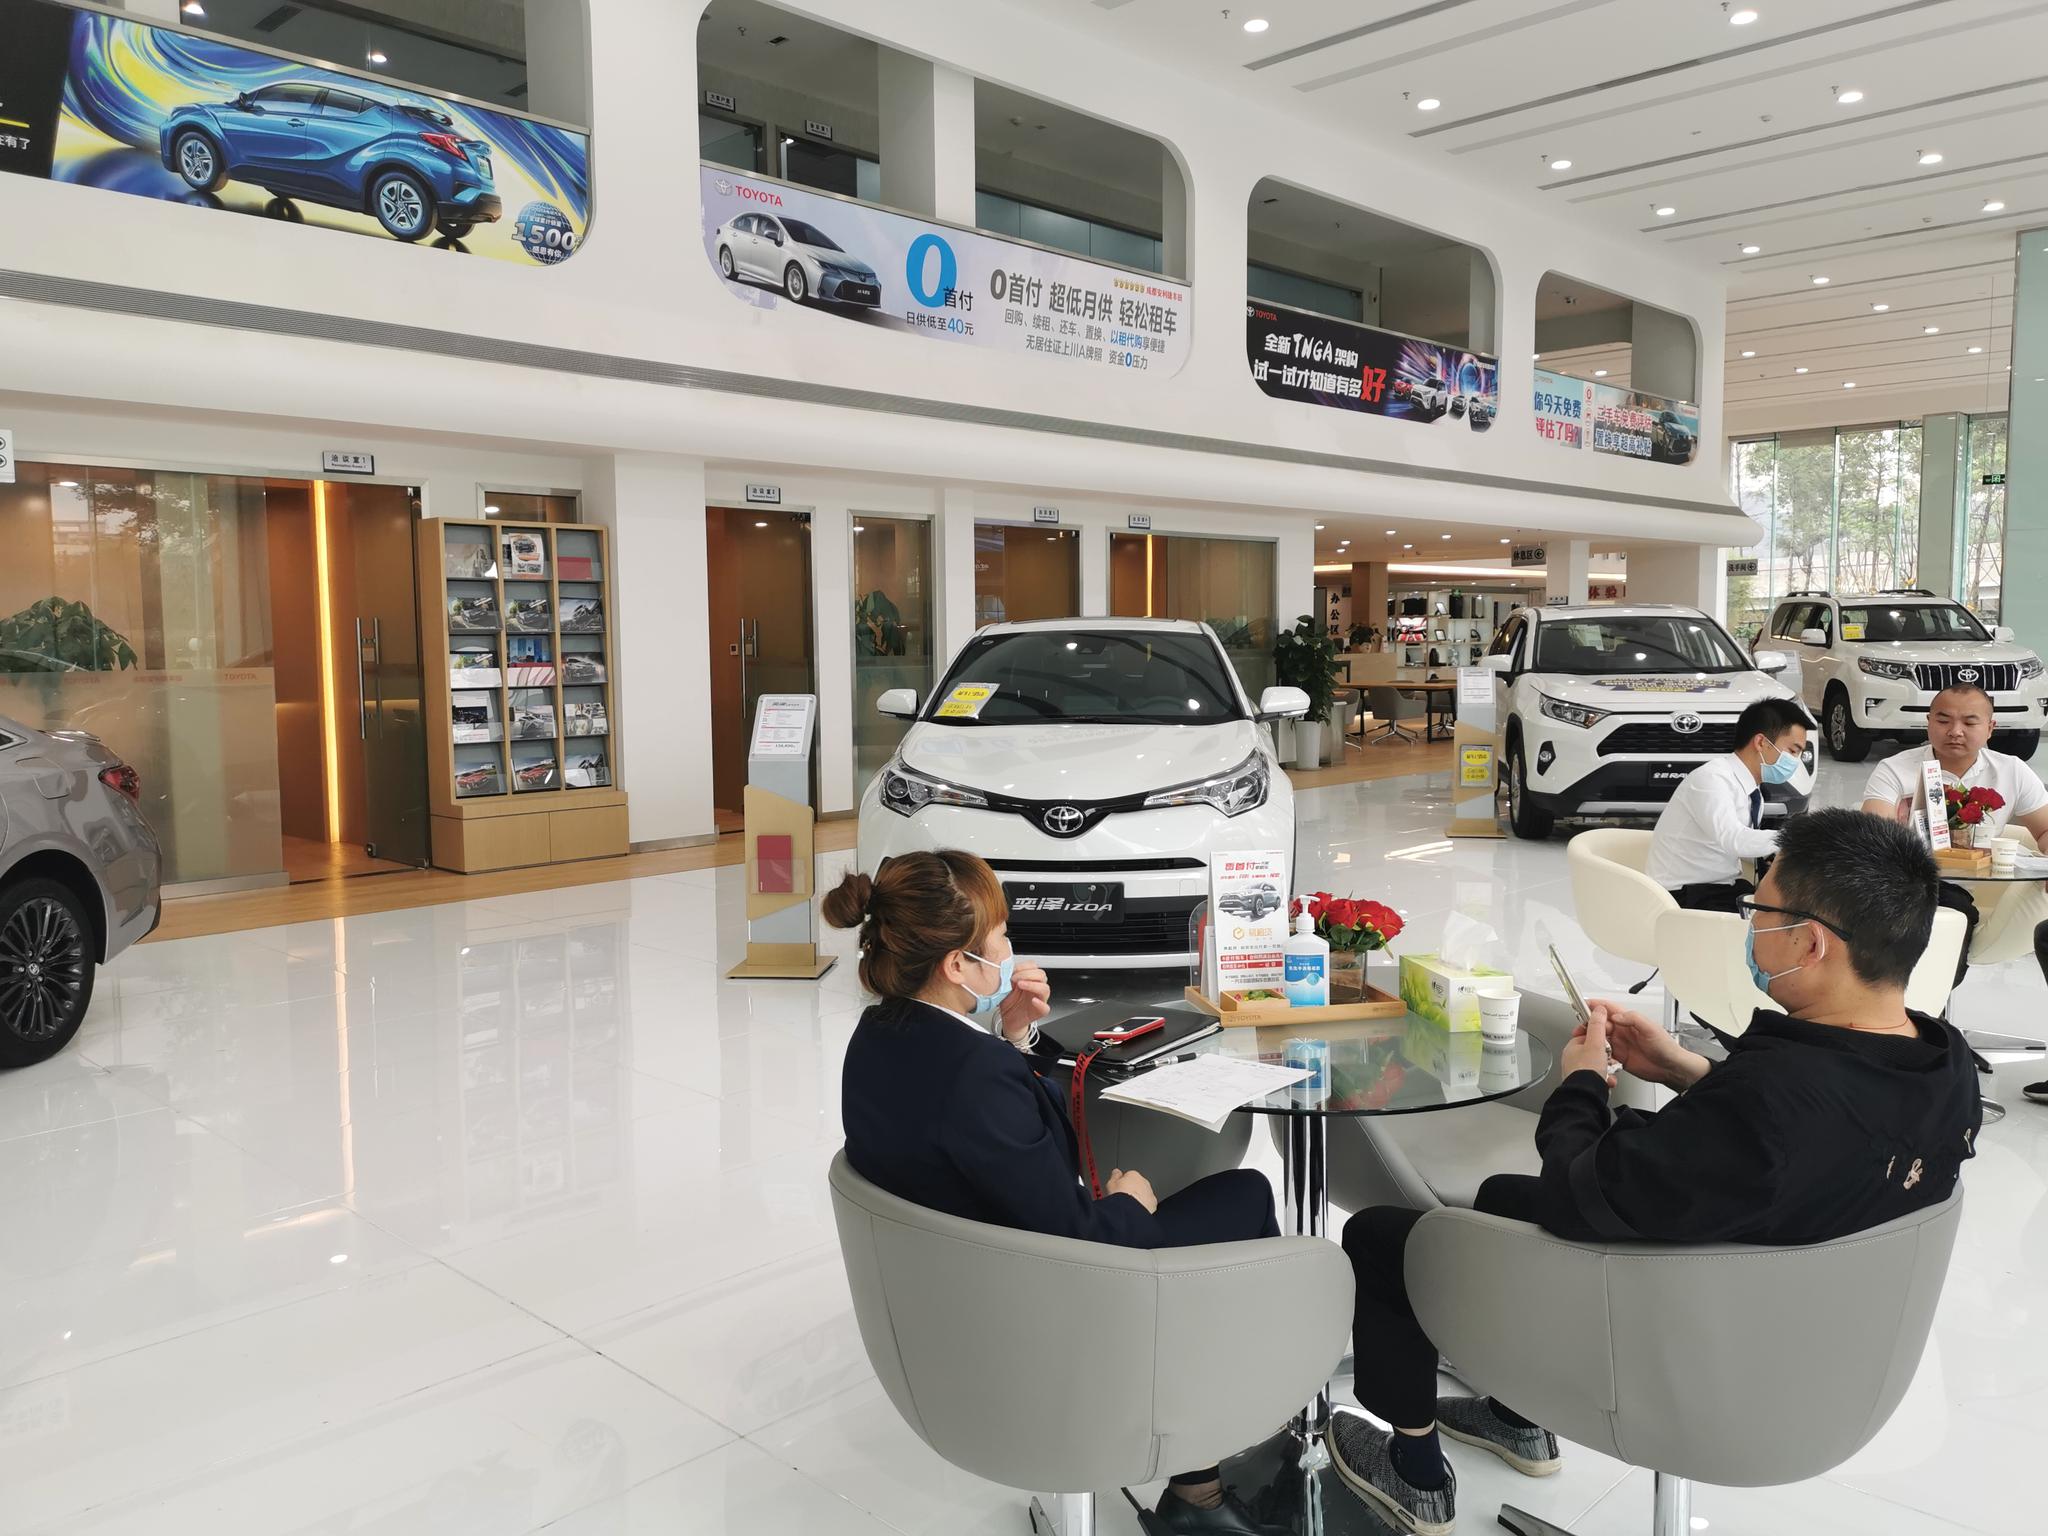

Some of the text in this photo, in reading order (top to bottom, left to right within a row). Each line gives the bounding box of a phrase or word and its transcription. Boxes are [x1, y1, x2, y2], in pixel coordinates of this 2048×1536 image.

[736, 185, 783, 207] TOYOTA
[990, 268, 1177, 336] 0首付 超低月供 轻松租车
[906, 311, 975, 336] 日供低至40元
[1255, 309, 1278, 321] TOYOTA
[1108, 349, 1148, 370] 资金0压力
[1264, 333, 1359, 369] 全新 TNGA 架构
[1253, 359, 1387, 403] 试一试才知道有多好
[1534, 391, 1582, 419] 你今天免费
[1513, 549, 1533, 561] 休息区
[1588, 585, 1626, 599] 体验
[1330, 592, 1340, 635] 办公区
[1011, 896, 1113, 911] 奕泽 IZOA
